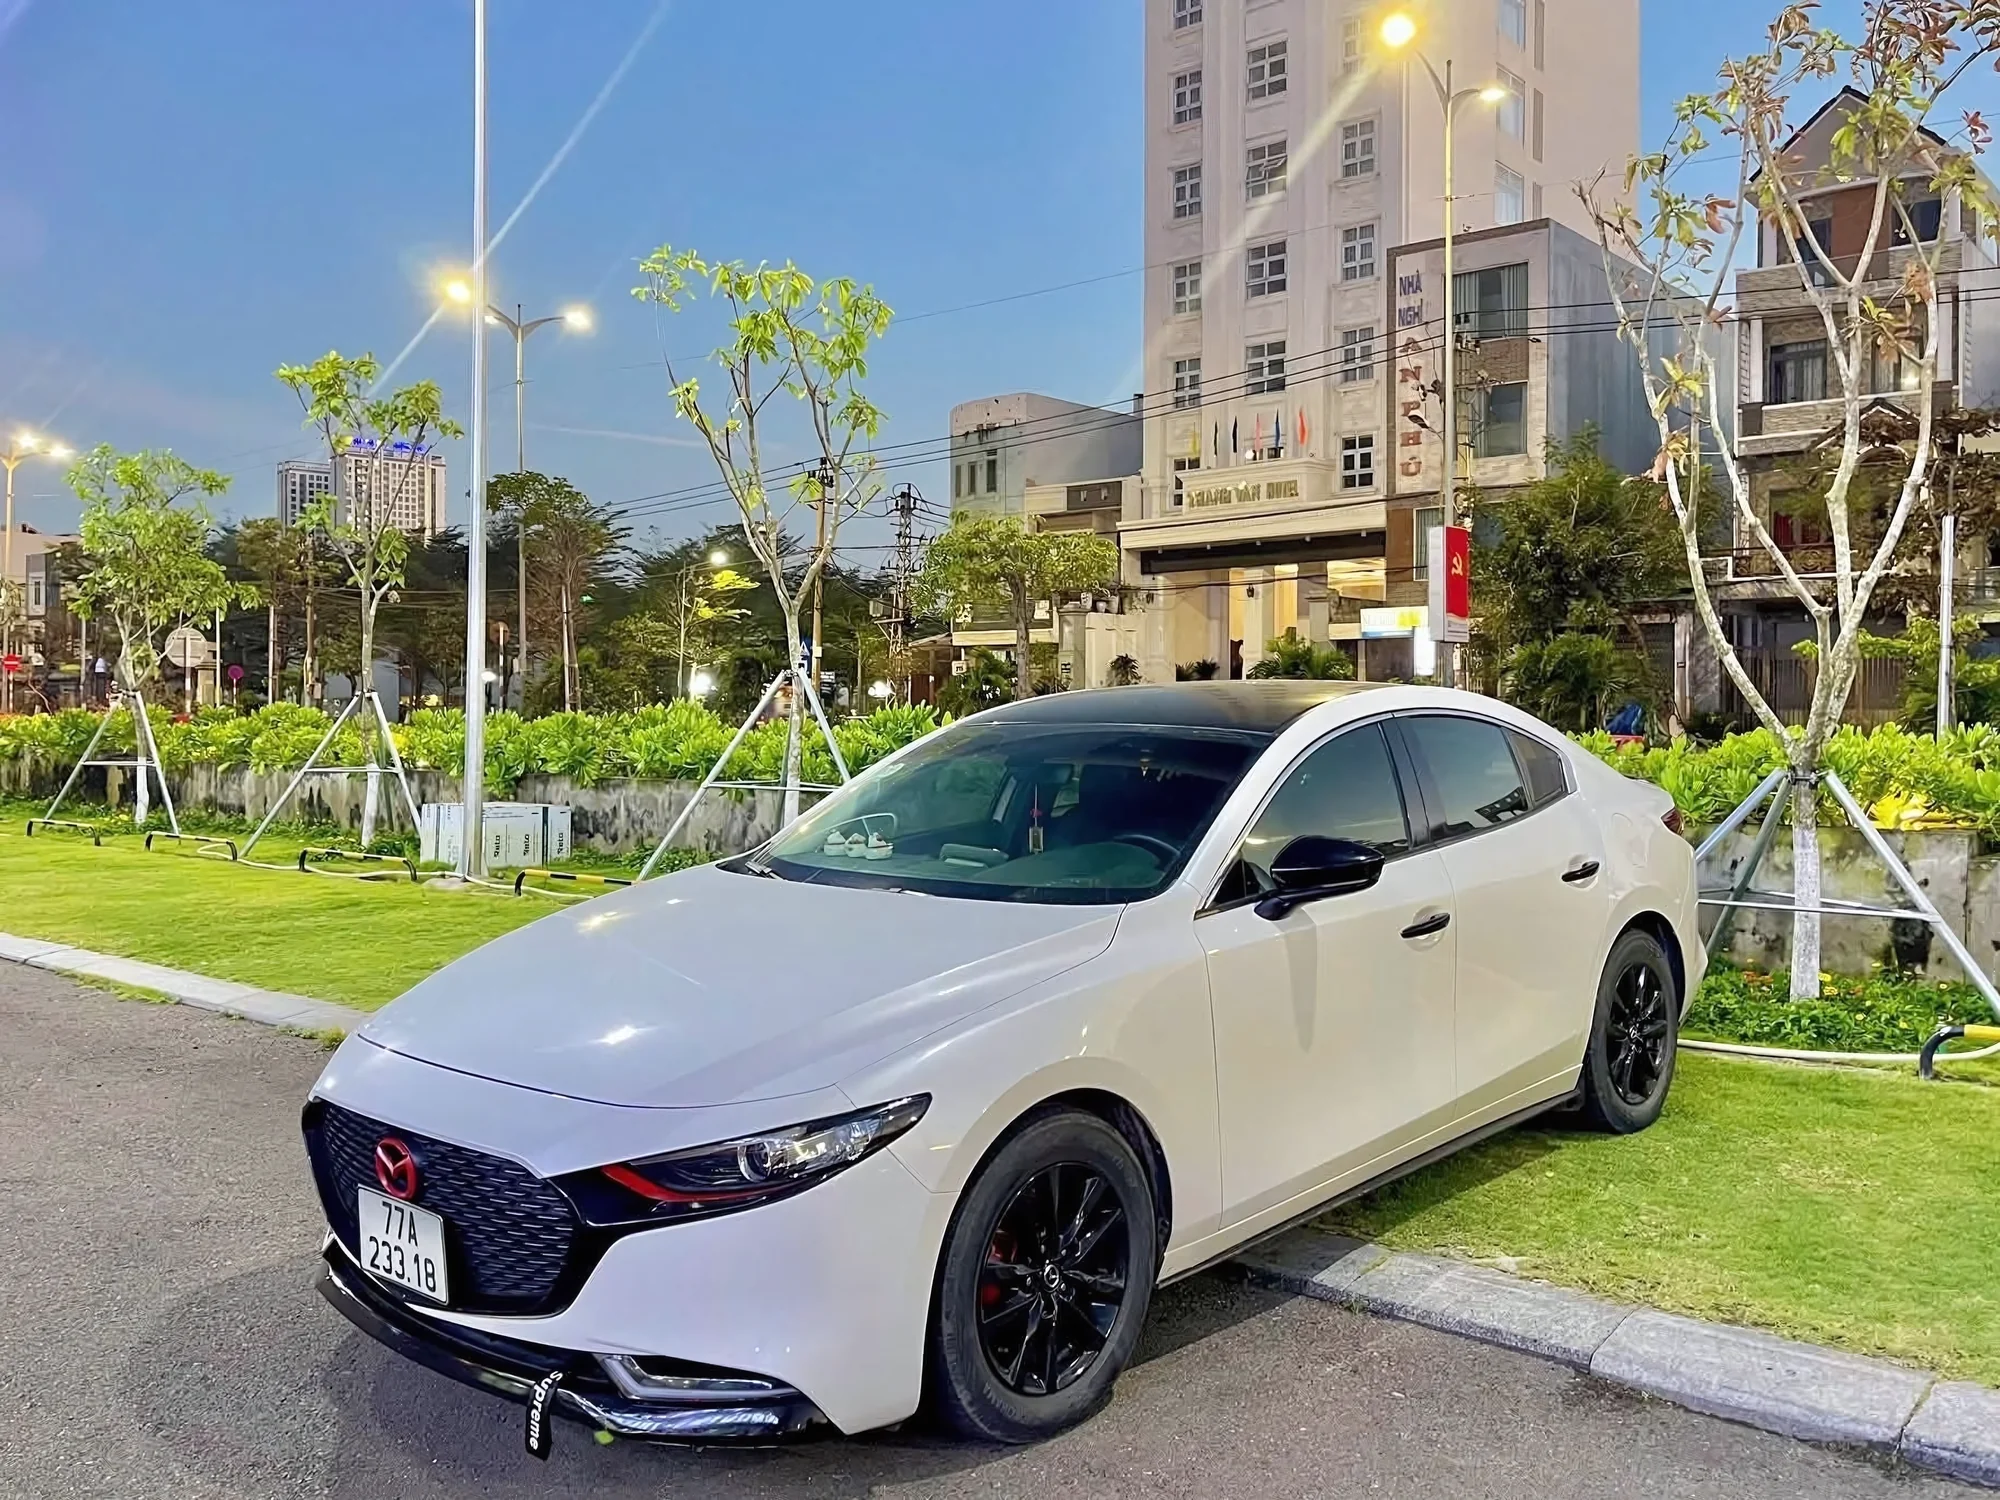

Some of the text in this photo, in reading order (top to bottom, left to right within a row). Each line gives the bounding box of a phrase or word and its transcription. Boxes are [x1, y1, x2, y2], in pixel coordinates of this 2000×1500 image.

[1399, 268, 1423, 297] NHÀ
[381, 1200, 419, 1247] 77A
[369, 1235, 437, 1292] 233.18
[529, 1370, 563, 1451] supreme
